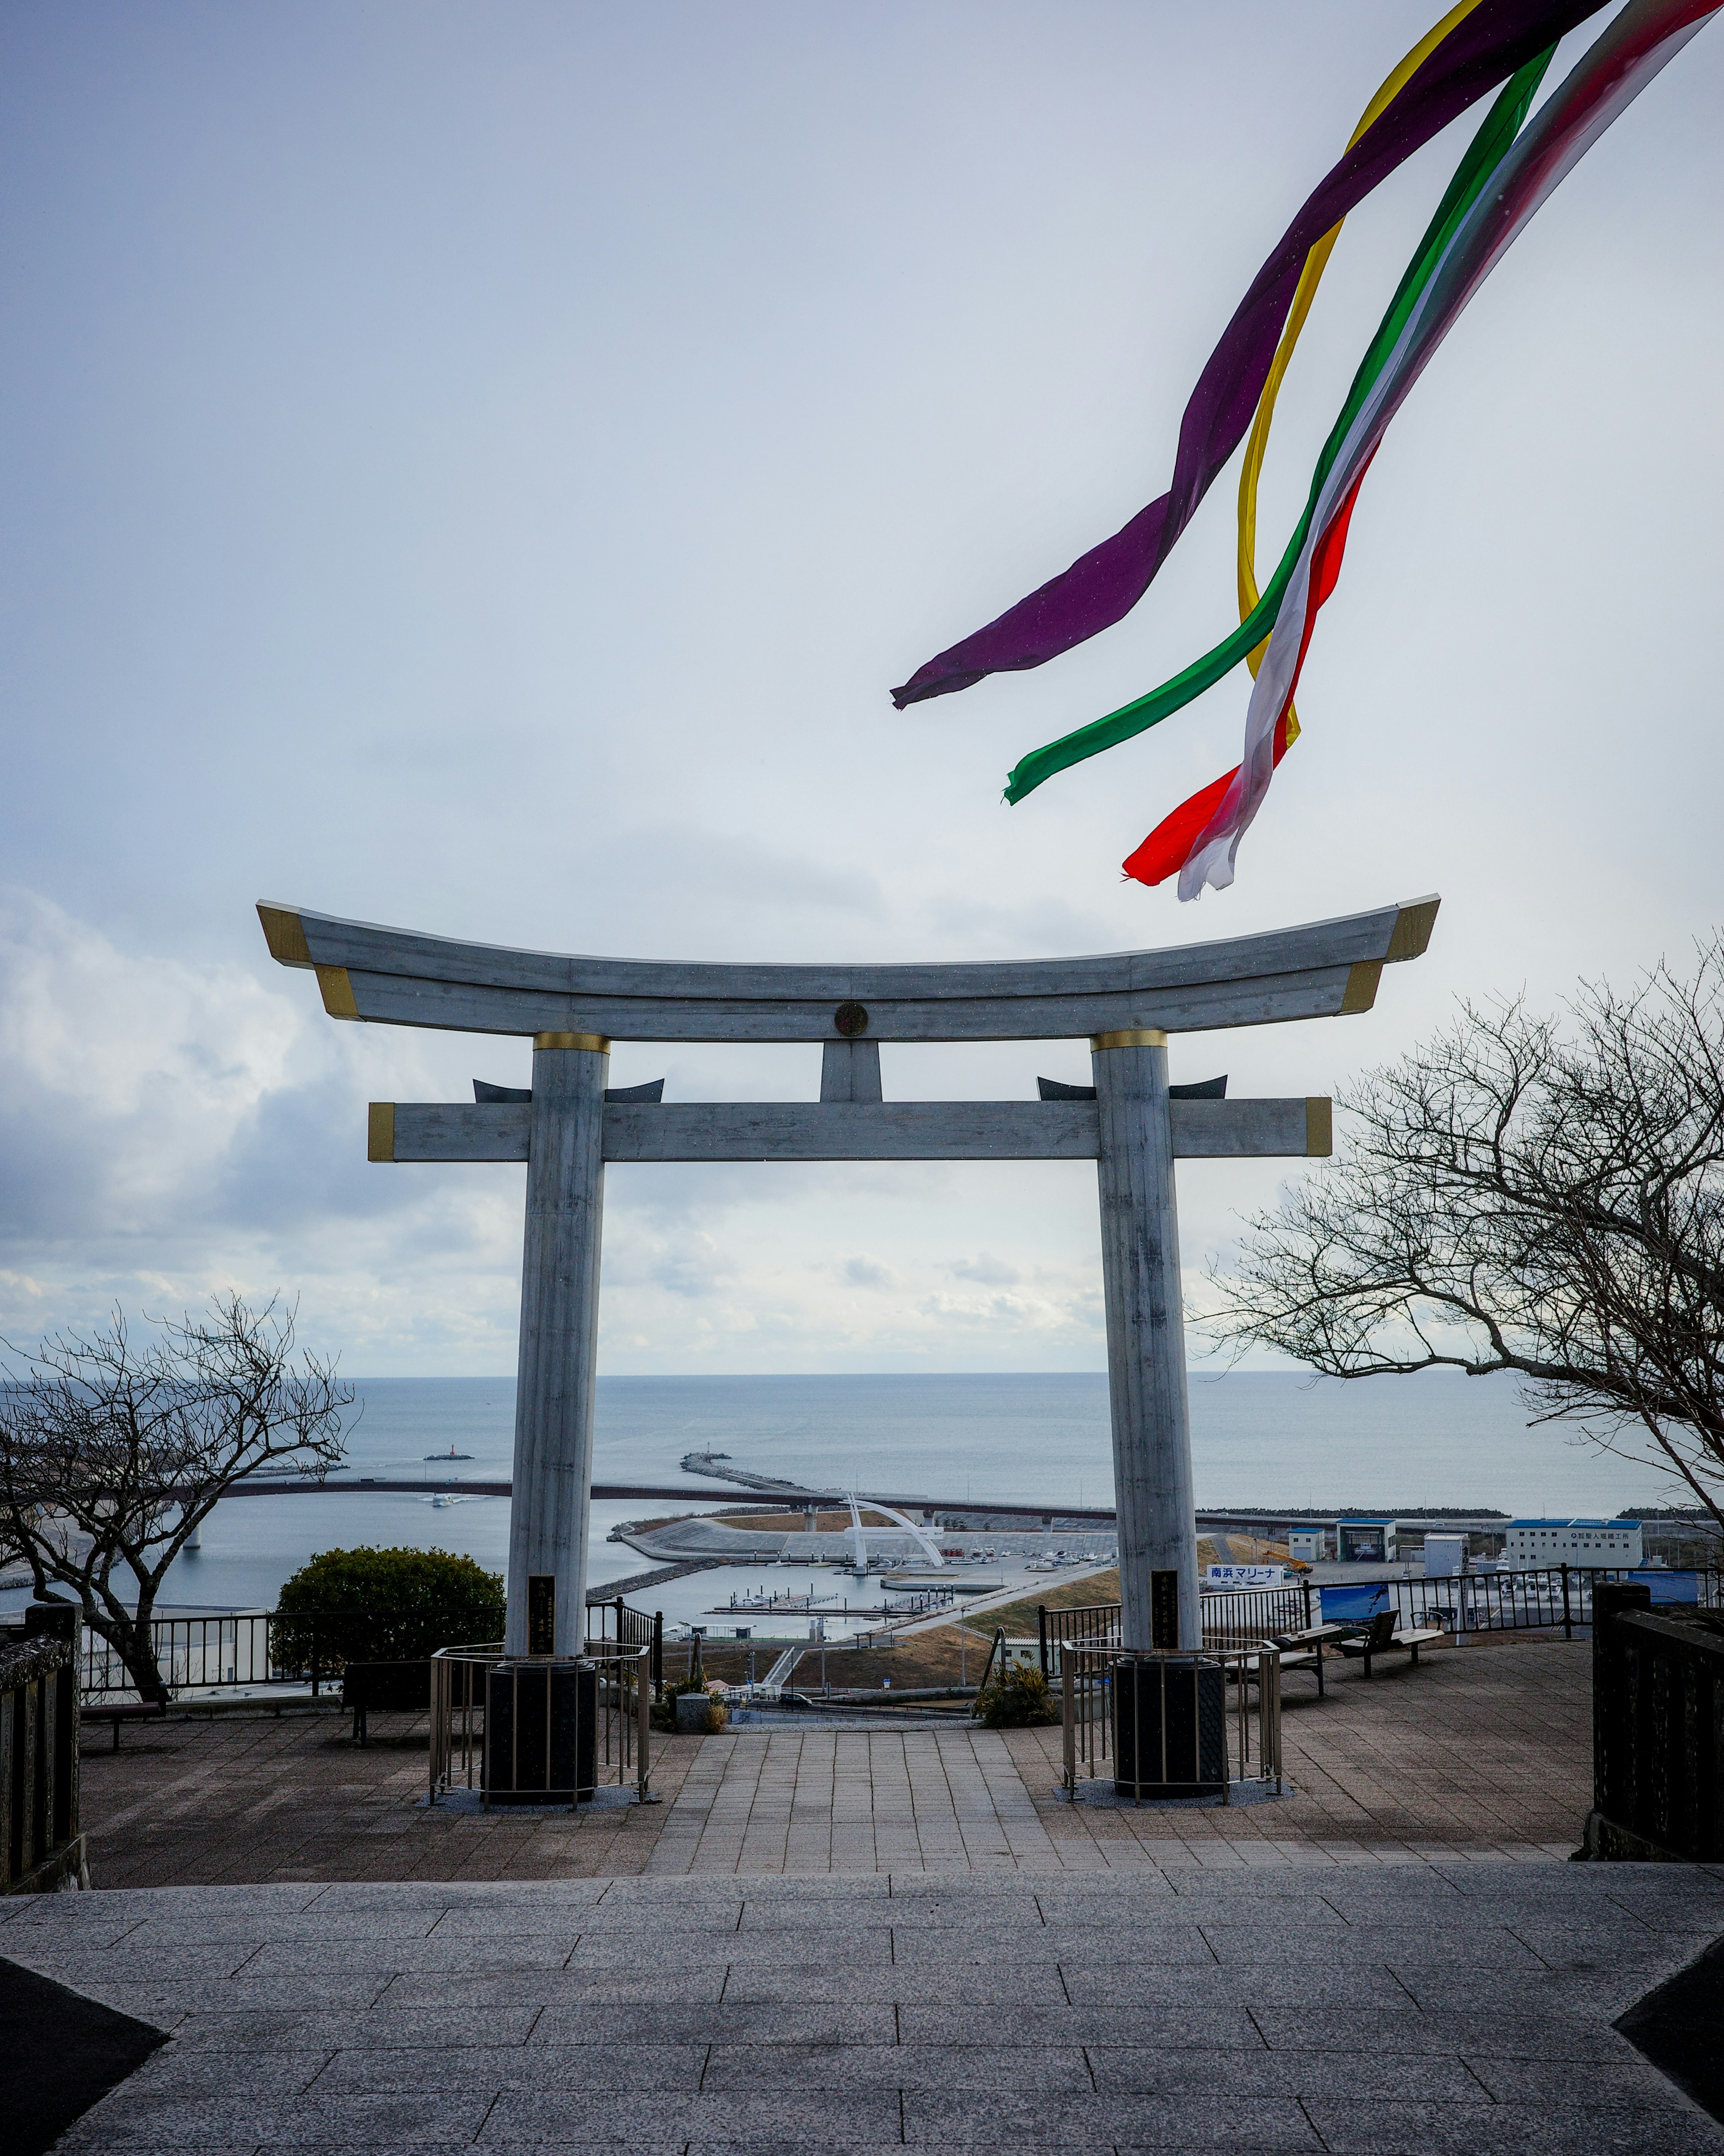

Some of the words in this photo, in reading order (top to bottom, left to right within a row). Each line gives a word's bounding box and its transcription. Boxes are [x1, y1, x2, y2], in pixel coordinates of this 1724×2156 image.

[1211, 1567, 1275, 1578] 南浜マリーナ
